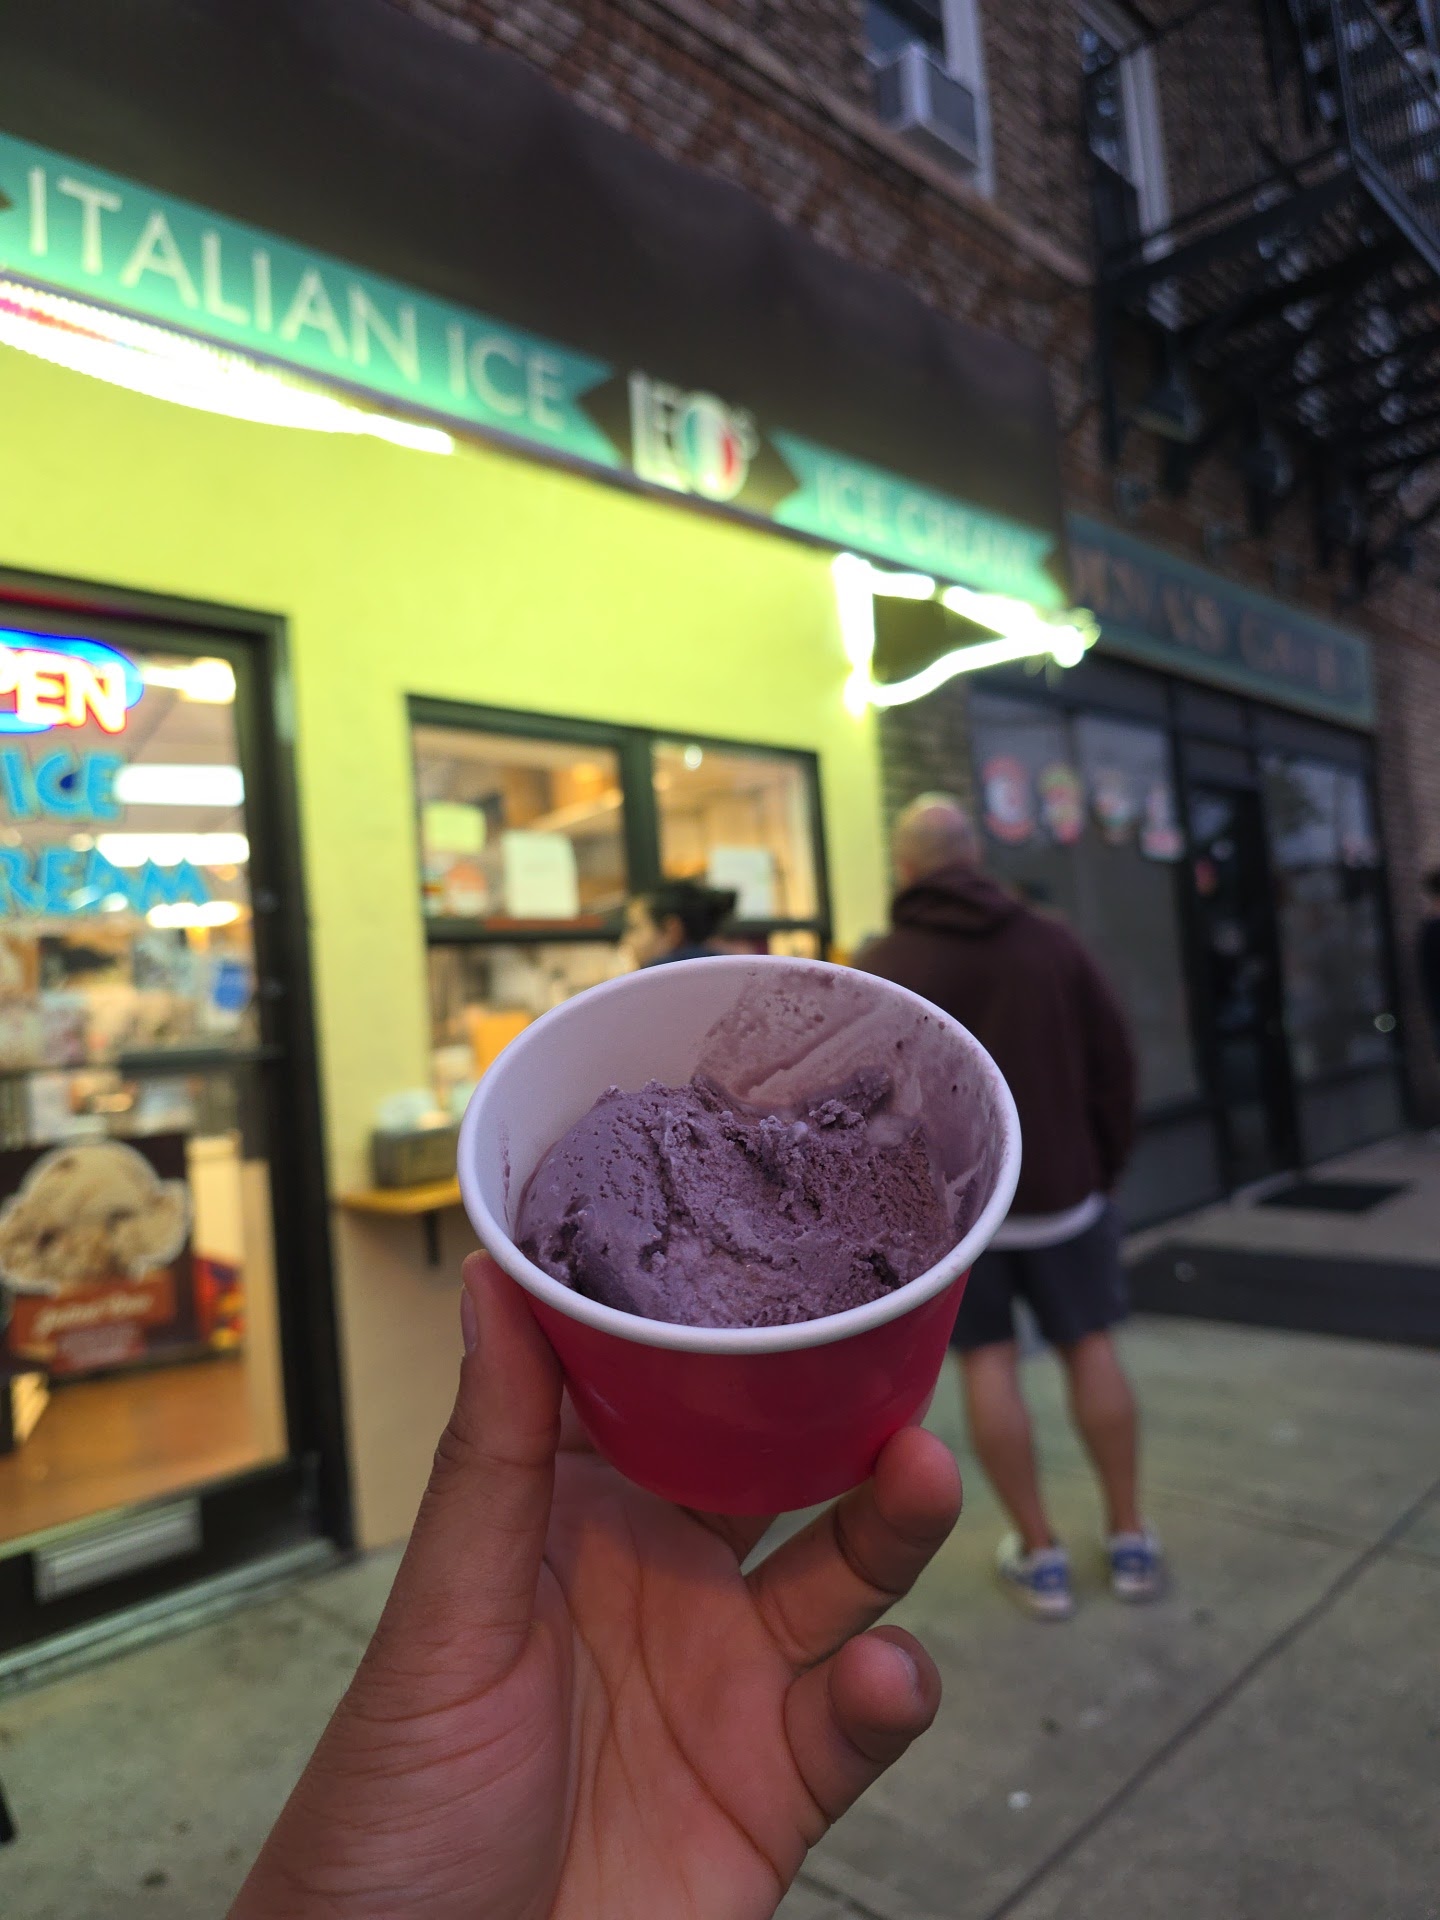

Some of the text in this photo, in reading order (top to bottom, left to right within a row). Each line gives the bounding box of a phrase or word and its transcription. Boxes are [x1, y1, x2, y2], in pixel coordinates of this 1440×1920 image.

[27, 164, 567, 434] ITALIAN ICE
[1, 749, 121, 822] ICE
